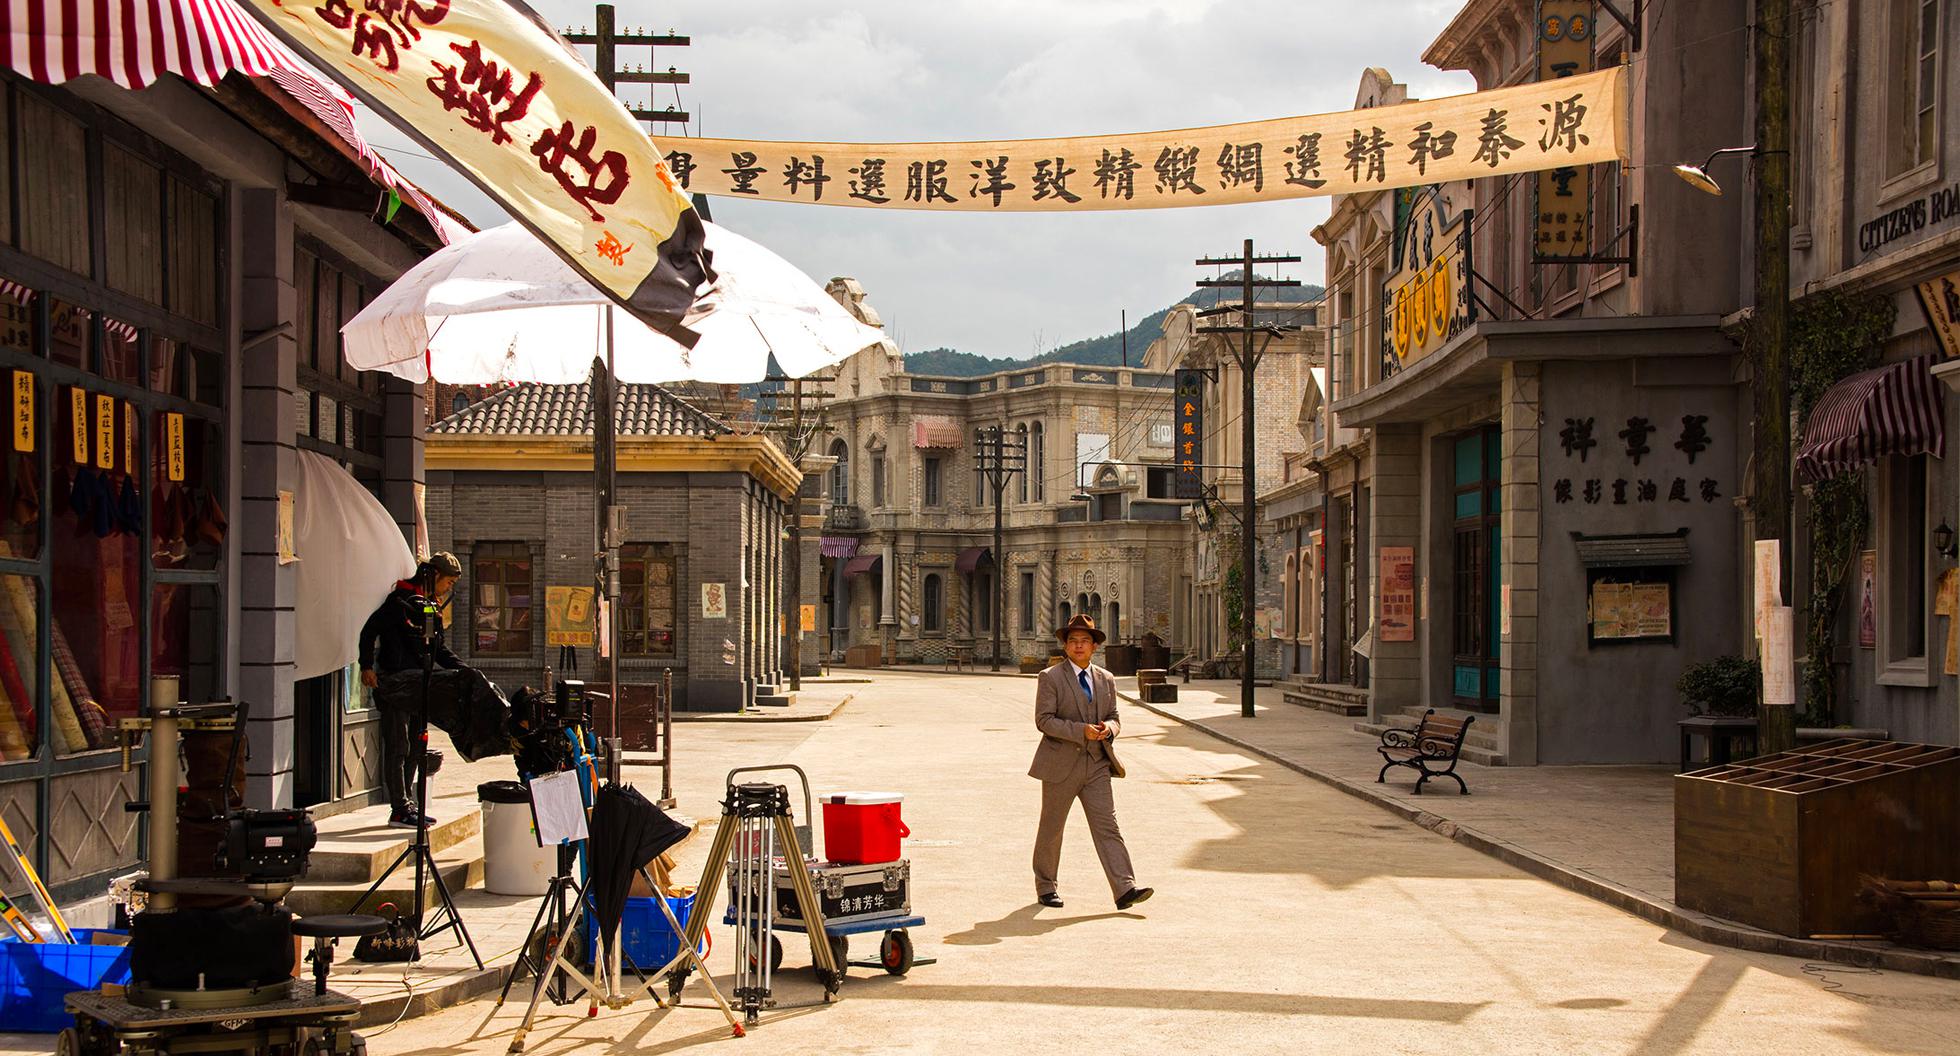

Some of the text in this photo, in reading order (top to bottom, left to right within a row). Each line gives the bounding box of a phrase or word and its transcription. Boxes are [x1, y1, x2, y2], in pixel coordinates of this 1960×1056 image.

[1859, 199, 1926, 253] CITIZENS
[840, 894, 885, 913] 锦清芳华
